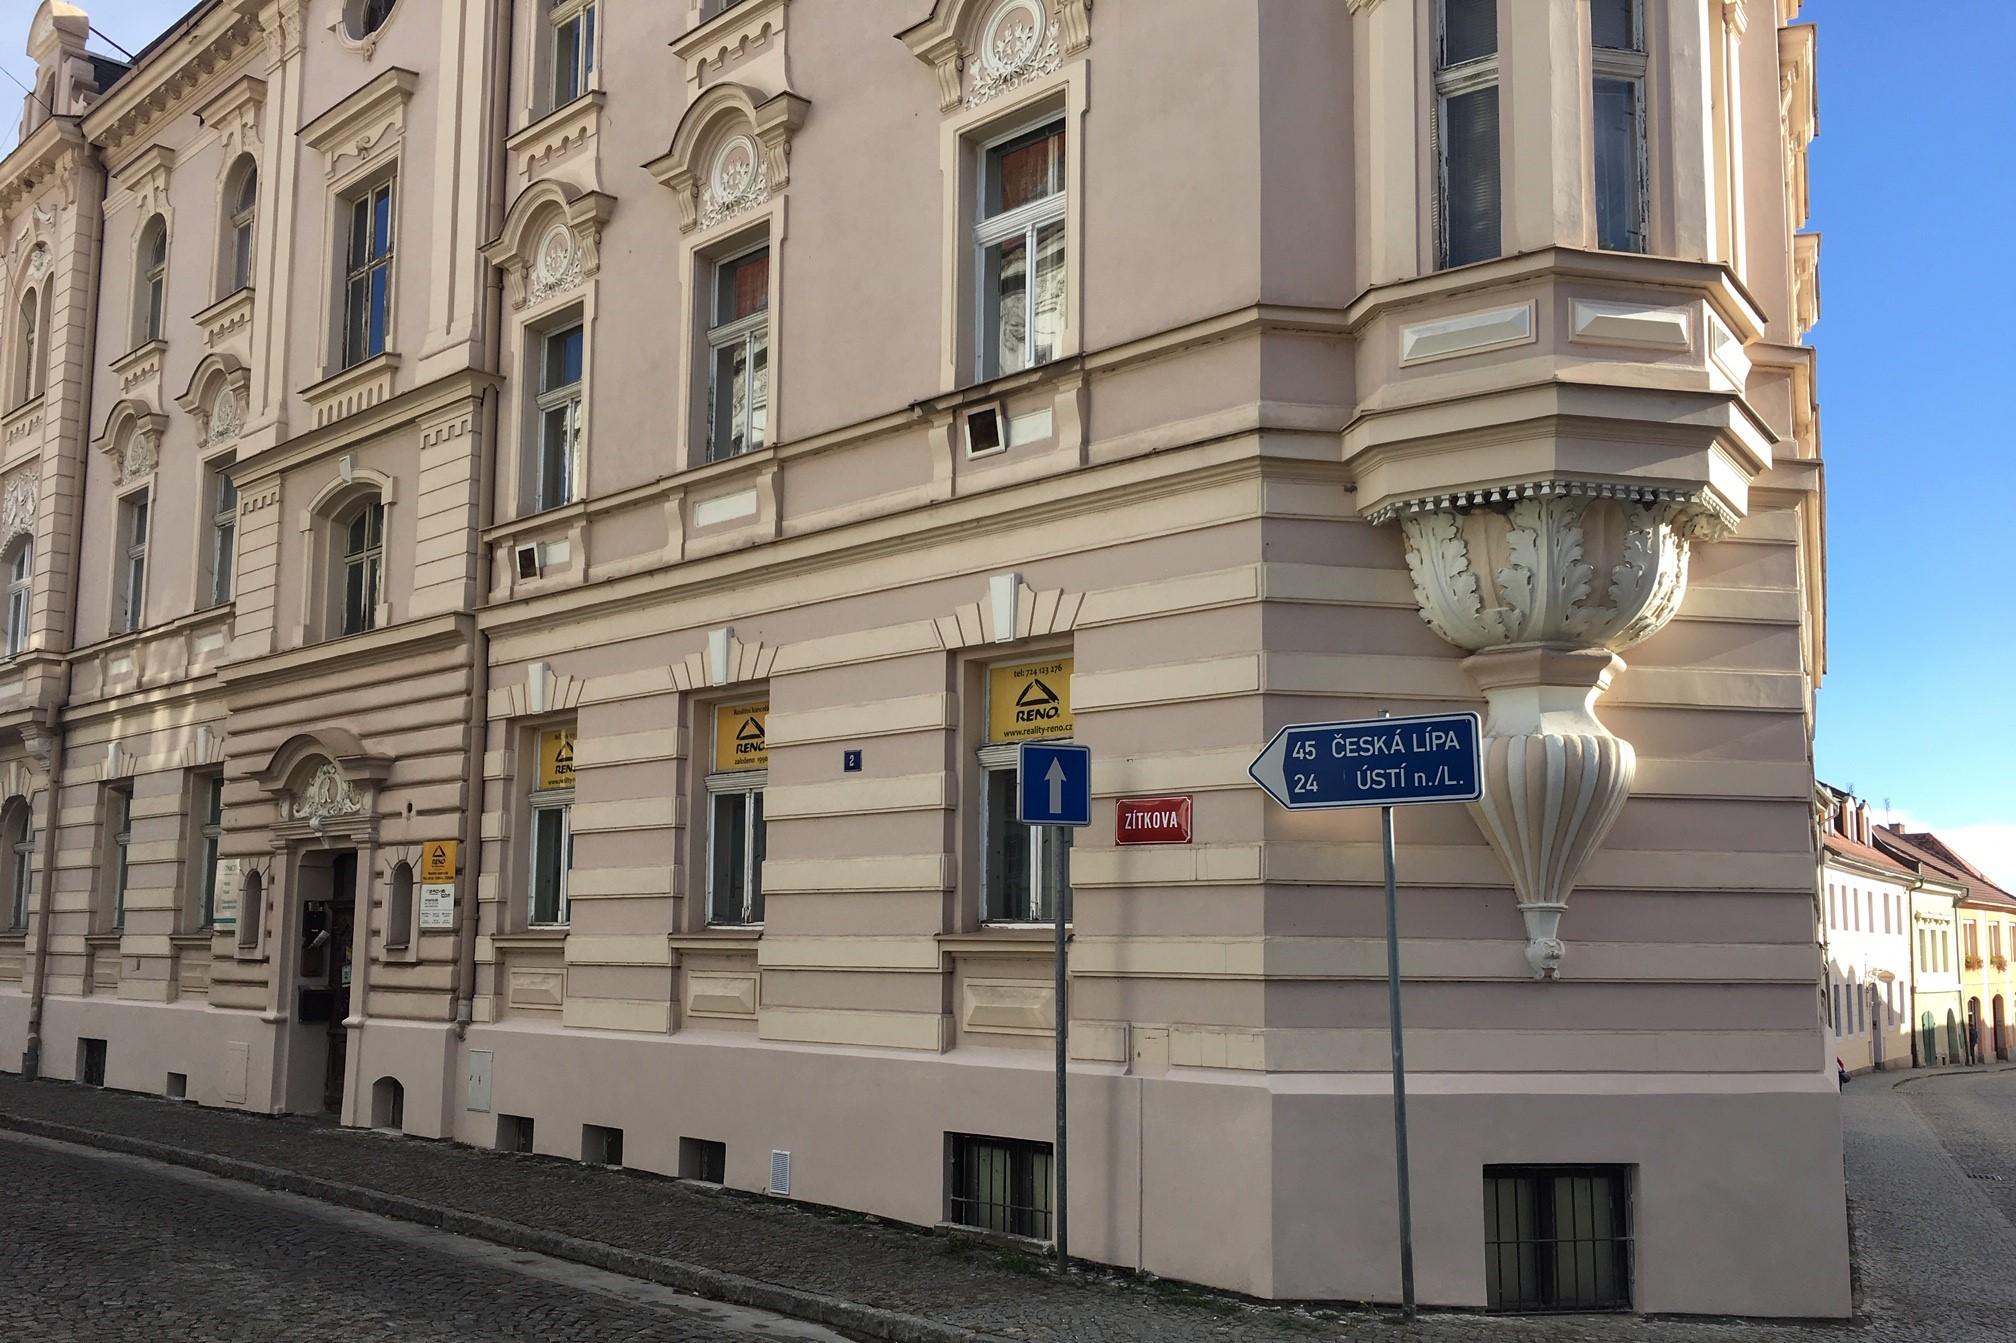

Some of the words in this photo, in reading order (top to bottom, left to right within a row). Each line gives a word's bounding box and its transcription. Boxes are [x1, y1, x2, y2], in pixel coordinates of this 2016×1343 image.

[1013, 669, 1025, 678] tel:
[1026, 667, 1037, 677] 724
[1039, 666, 1049, 675] 123
[1050, 664, 1062, 674] 276
[1015, 706, 1059, 723] RENO
[1003, 724, 1073, 738] www.reality-reno.cz
[1292, 740, 1317, 761] 45
[1331, 729, 1406, 759] ČESKÁ
[1412, 727, 1461, 752] LÍPA
[554, 764, 576, 775] REN
[1294, 773, 1319, 793] 24
[1356, 764, 1406, 790] ÚSTÍ
[1413, 765, 1465, 787] n./L.
[1124, 809, 1179, 830] ZÍTKOVA
